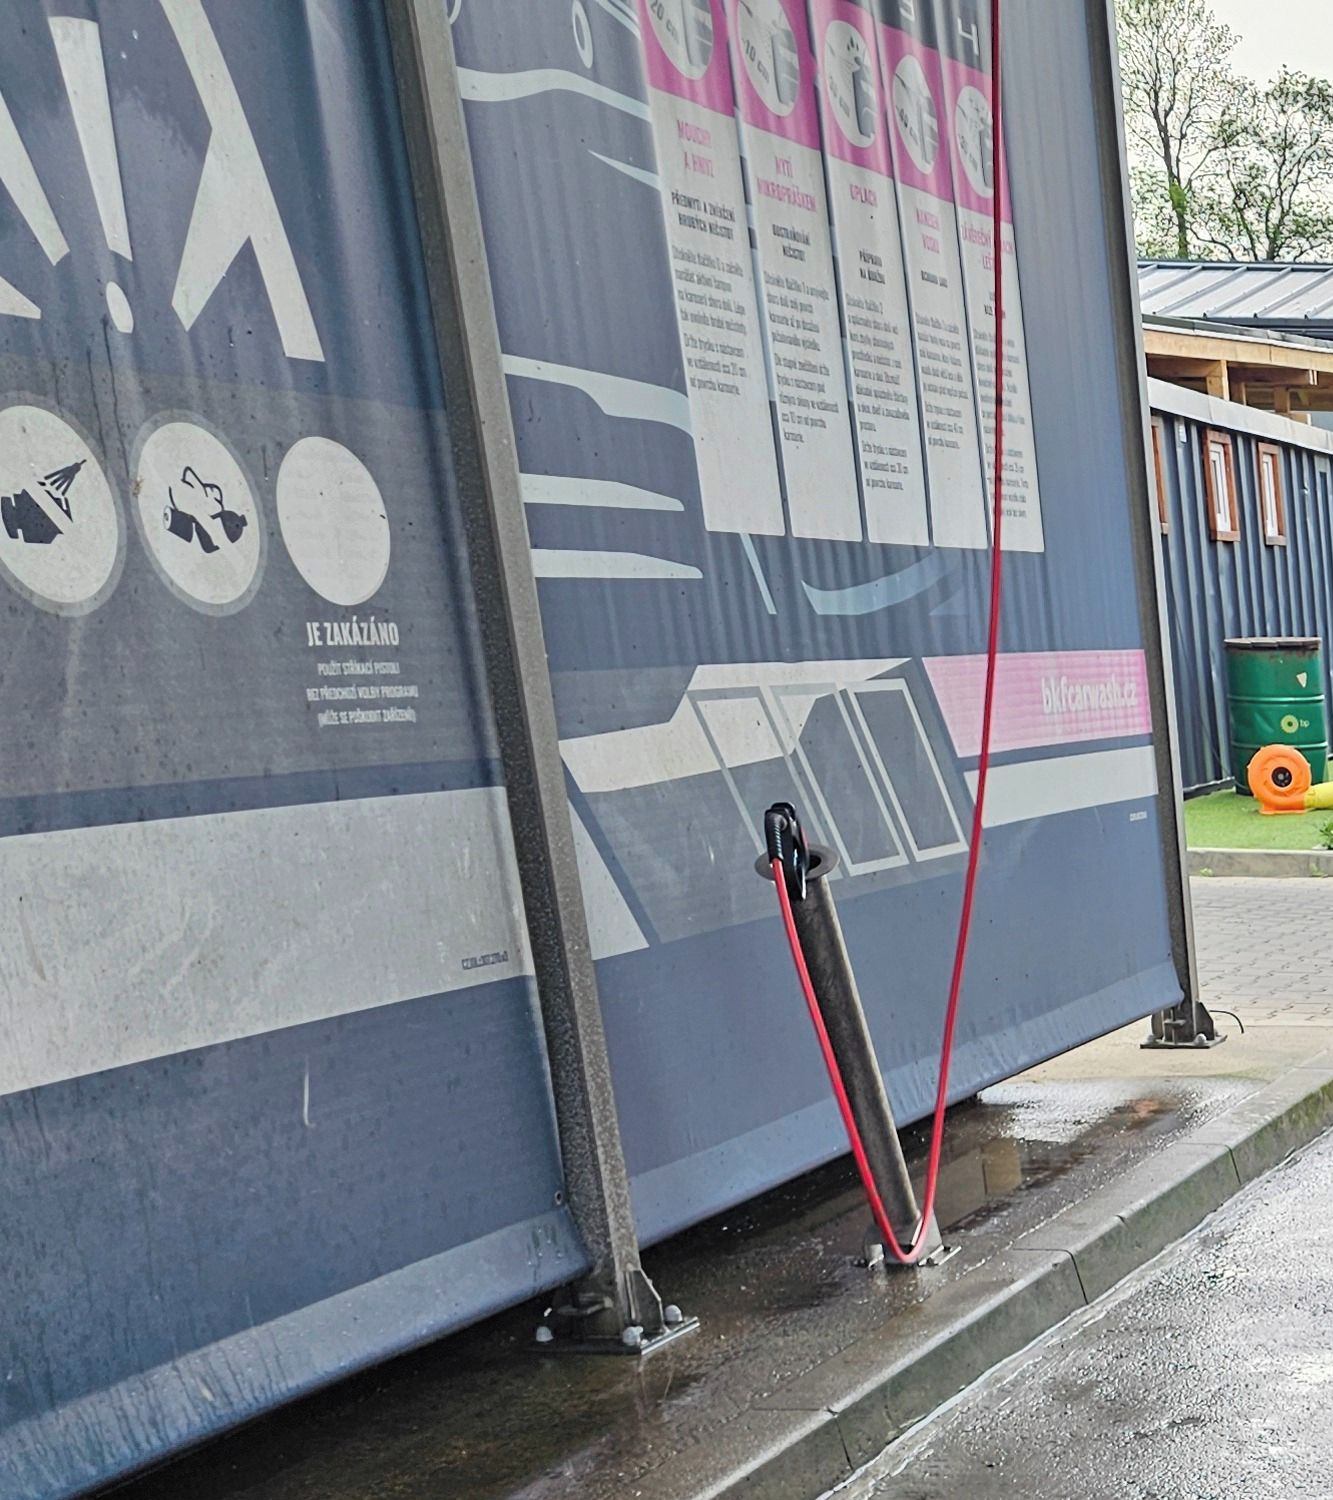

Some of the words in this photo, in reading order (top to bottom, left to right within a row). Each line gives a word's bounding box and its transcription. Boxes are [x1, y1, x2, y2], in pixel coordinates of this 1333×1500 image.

[306, 621, 323, 647] JE
[323, 615, 400, 647] ZAKÁZÁNO
[1041, 673, 1138, 714] bkfcarwash.cz
